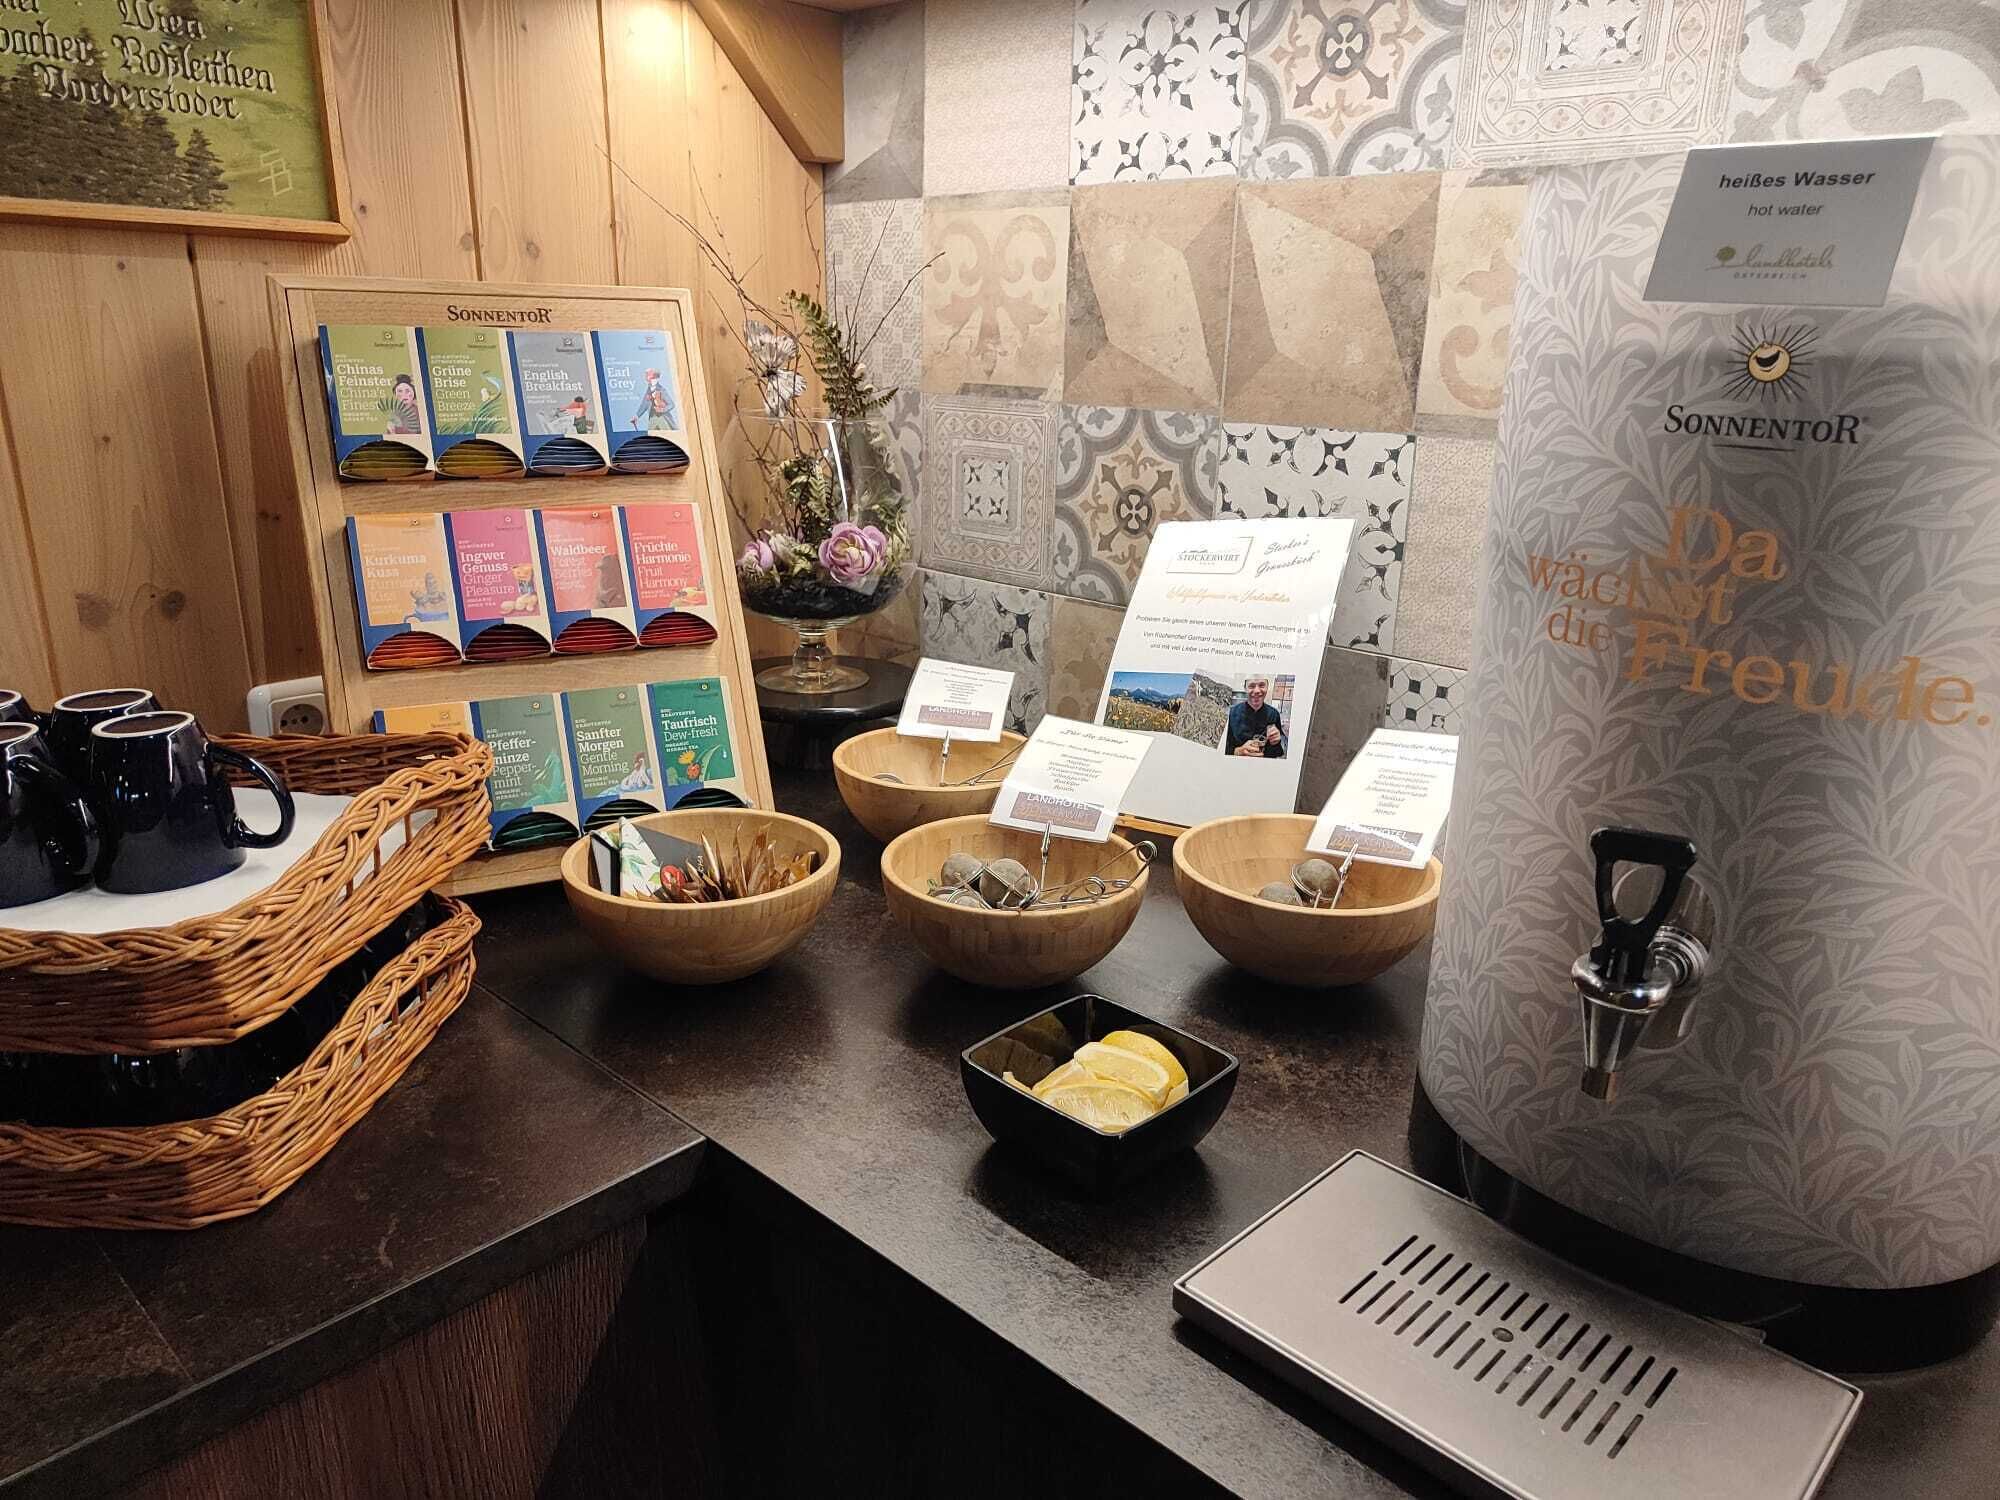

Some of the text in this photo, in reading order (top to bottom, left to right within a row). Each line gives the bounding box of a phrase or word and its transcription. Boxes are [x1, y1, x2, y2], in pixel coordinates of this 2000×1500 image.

[1718, 171, 1876, 188] heißes Wasser
[1747, 204, 1823, 217] hot water
[337, 365, 384, 375] Chinas
[432, 366, 472, 376] Grüne
[524, 370, 569, 382] English
[607, 367, 630, 378] Earl
[339, 376, 393, 387] Feinster
[435, 377, 466, 388] Brise
[525, 381, 583, 392] Breakfast
[608, 378, 636, 390] Grey
[435, 388, 470, 399] Green
[634, 541, 678, 553] Früchte
[1664, 504, 1786, 581] Da
[551, 544, 607, 556] Waldbeer
[461, 551, 506, 564] Ingwer
[636, 553, 691, 565] Harmonie
[463, 562, 508, 574] Genuss
[463, 573, 503, 586] Ginger
[465, 585, 515, 597] Pleasure
[1547, 605, 1615, 652] die
[1624, 615, 1991, 727] Freude.
[661, 715, 717, 730] Taufrisch
[576, 727, 622, 742] Sanfter
[664, 727, 719, 742] Dew-fresh
[489, 737, 537, 751] Pfeffer-
[578, 739, 625, 753] Morgen
[580, 750, 618, 764] Gentle
[582, 761, 630, 776] Morning
[494, 776, 522, 788] mint
